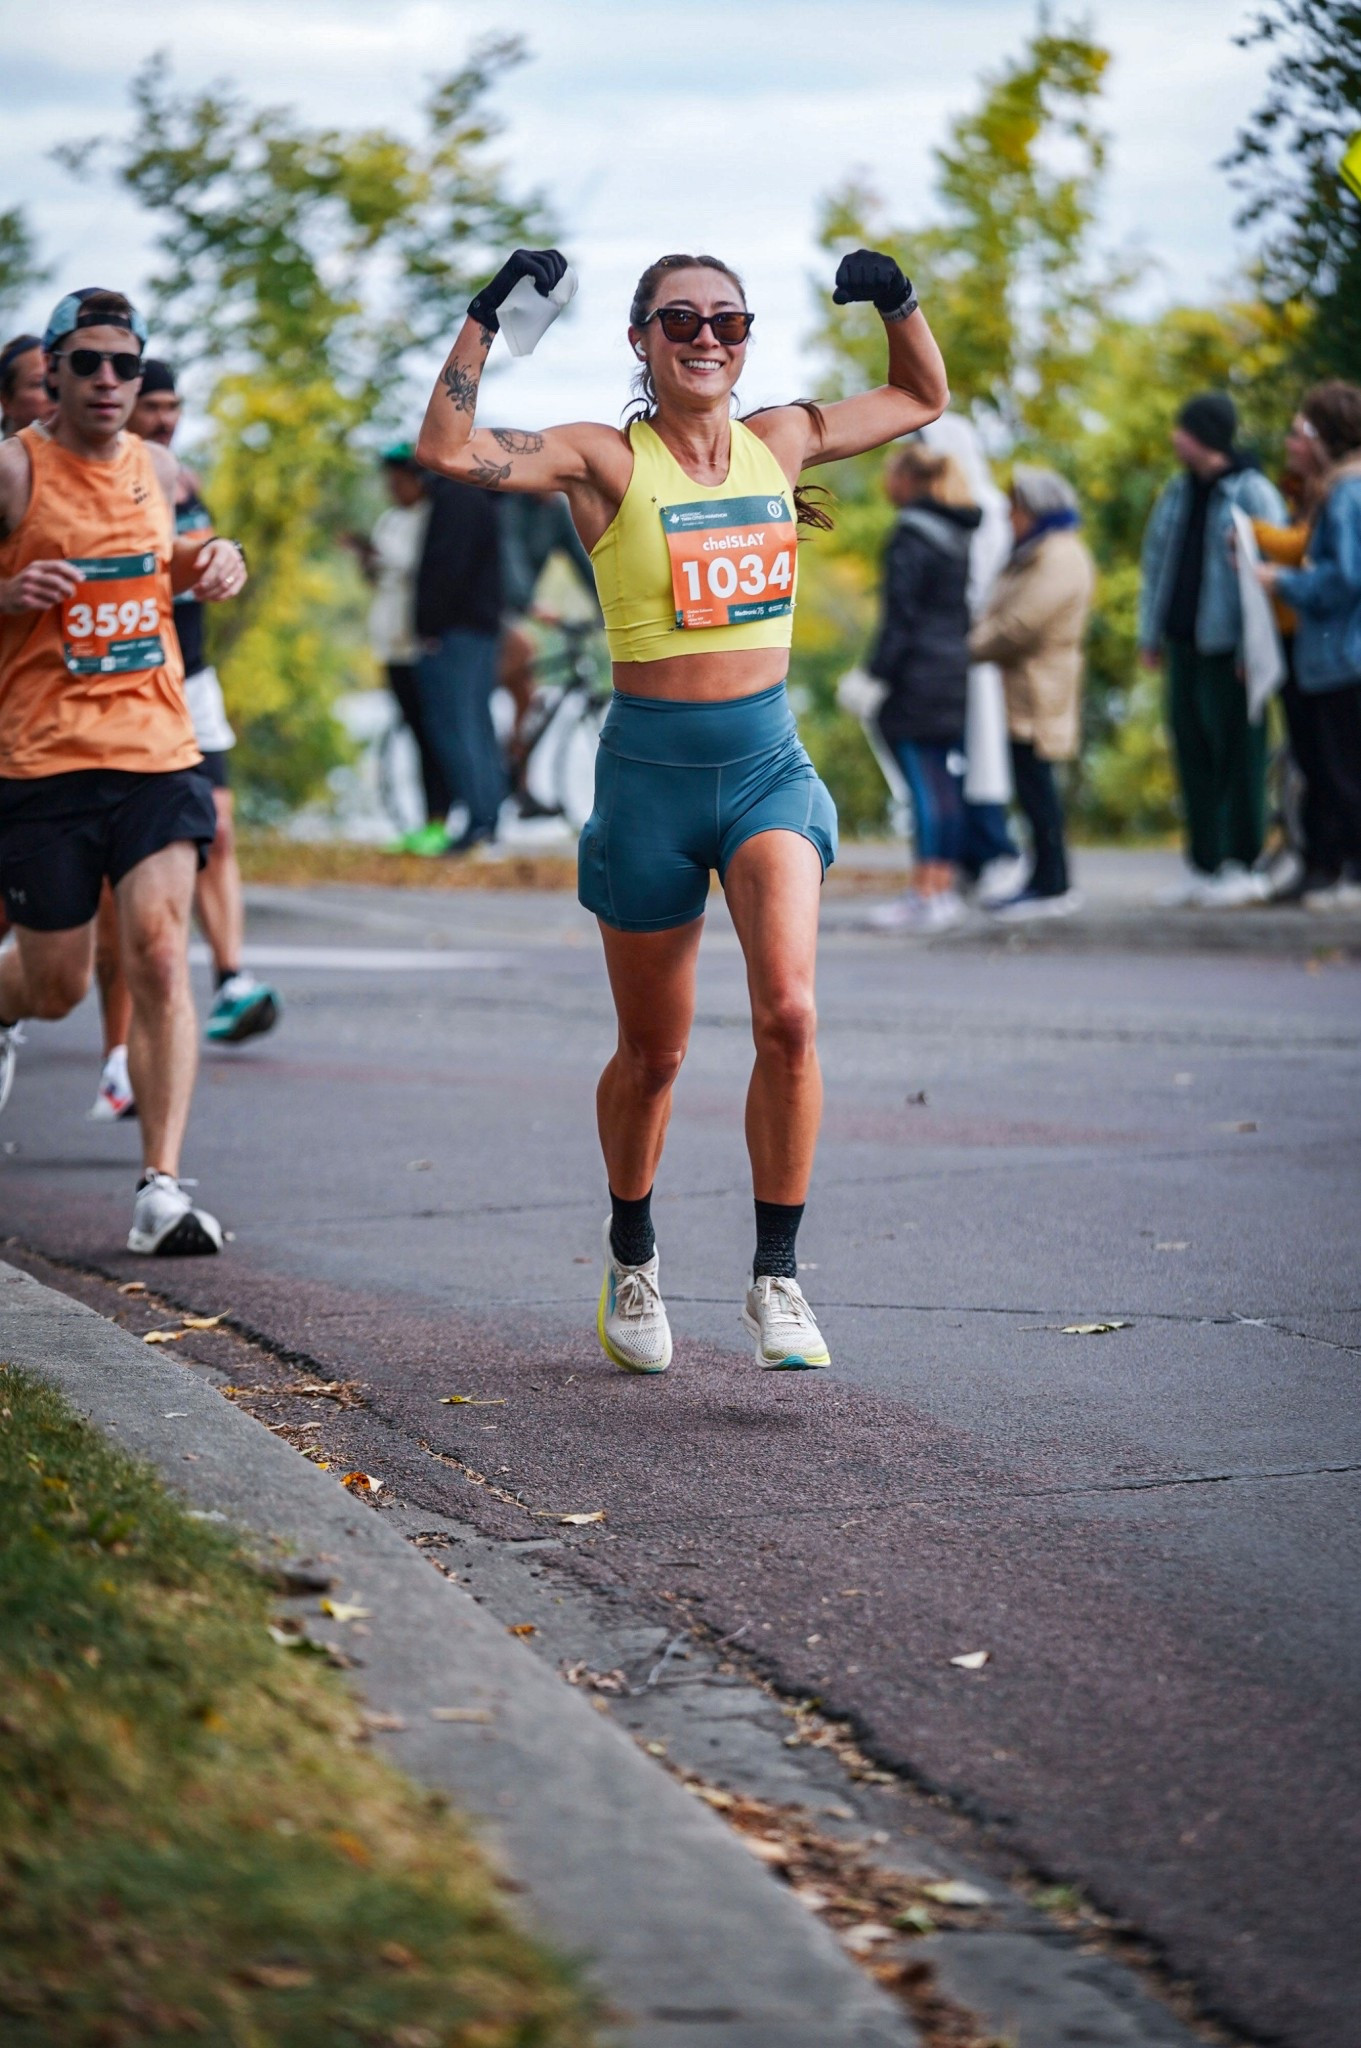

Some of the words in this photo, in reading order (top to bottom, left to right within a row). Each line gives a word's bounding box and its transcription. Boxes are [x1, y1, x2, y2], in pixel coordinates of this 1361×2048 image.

[703, 532, 765, 551] chelSLAY
[682, 551, 791, 601] 1034
[67, 598, 160, 638] 3595
